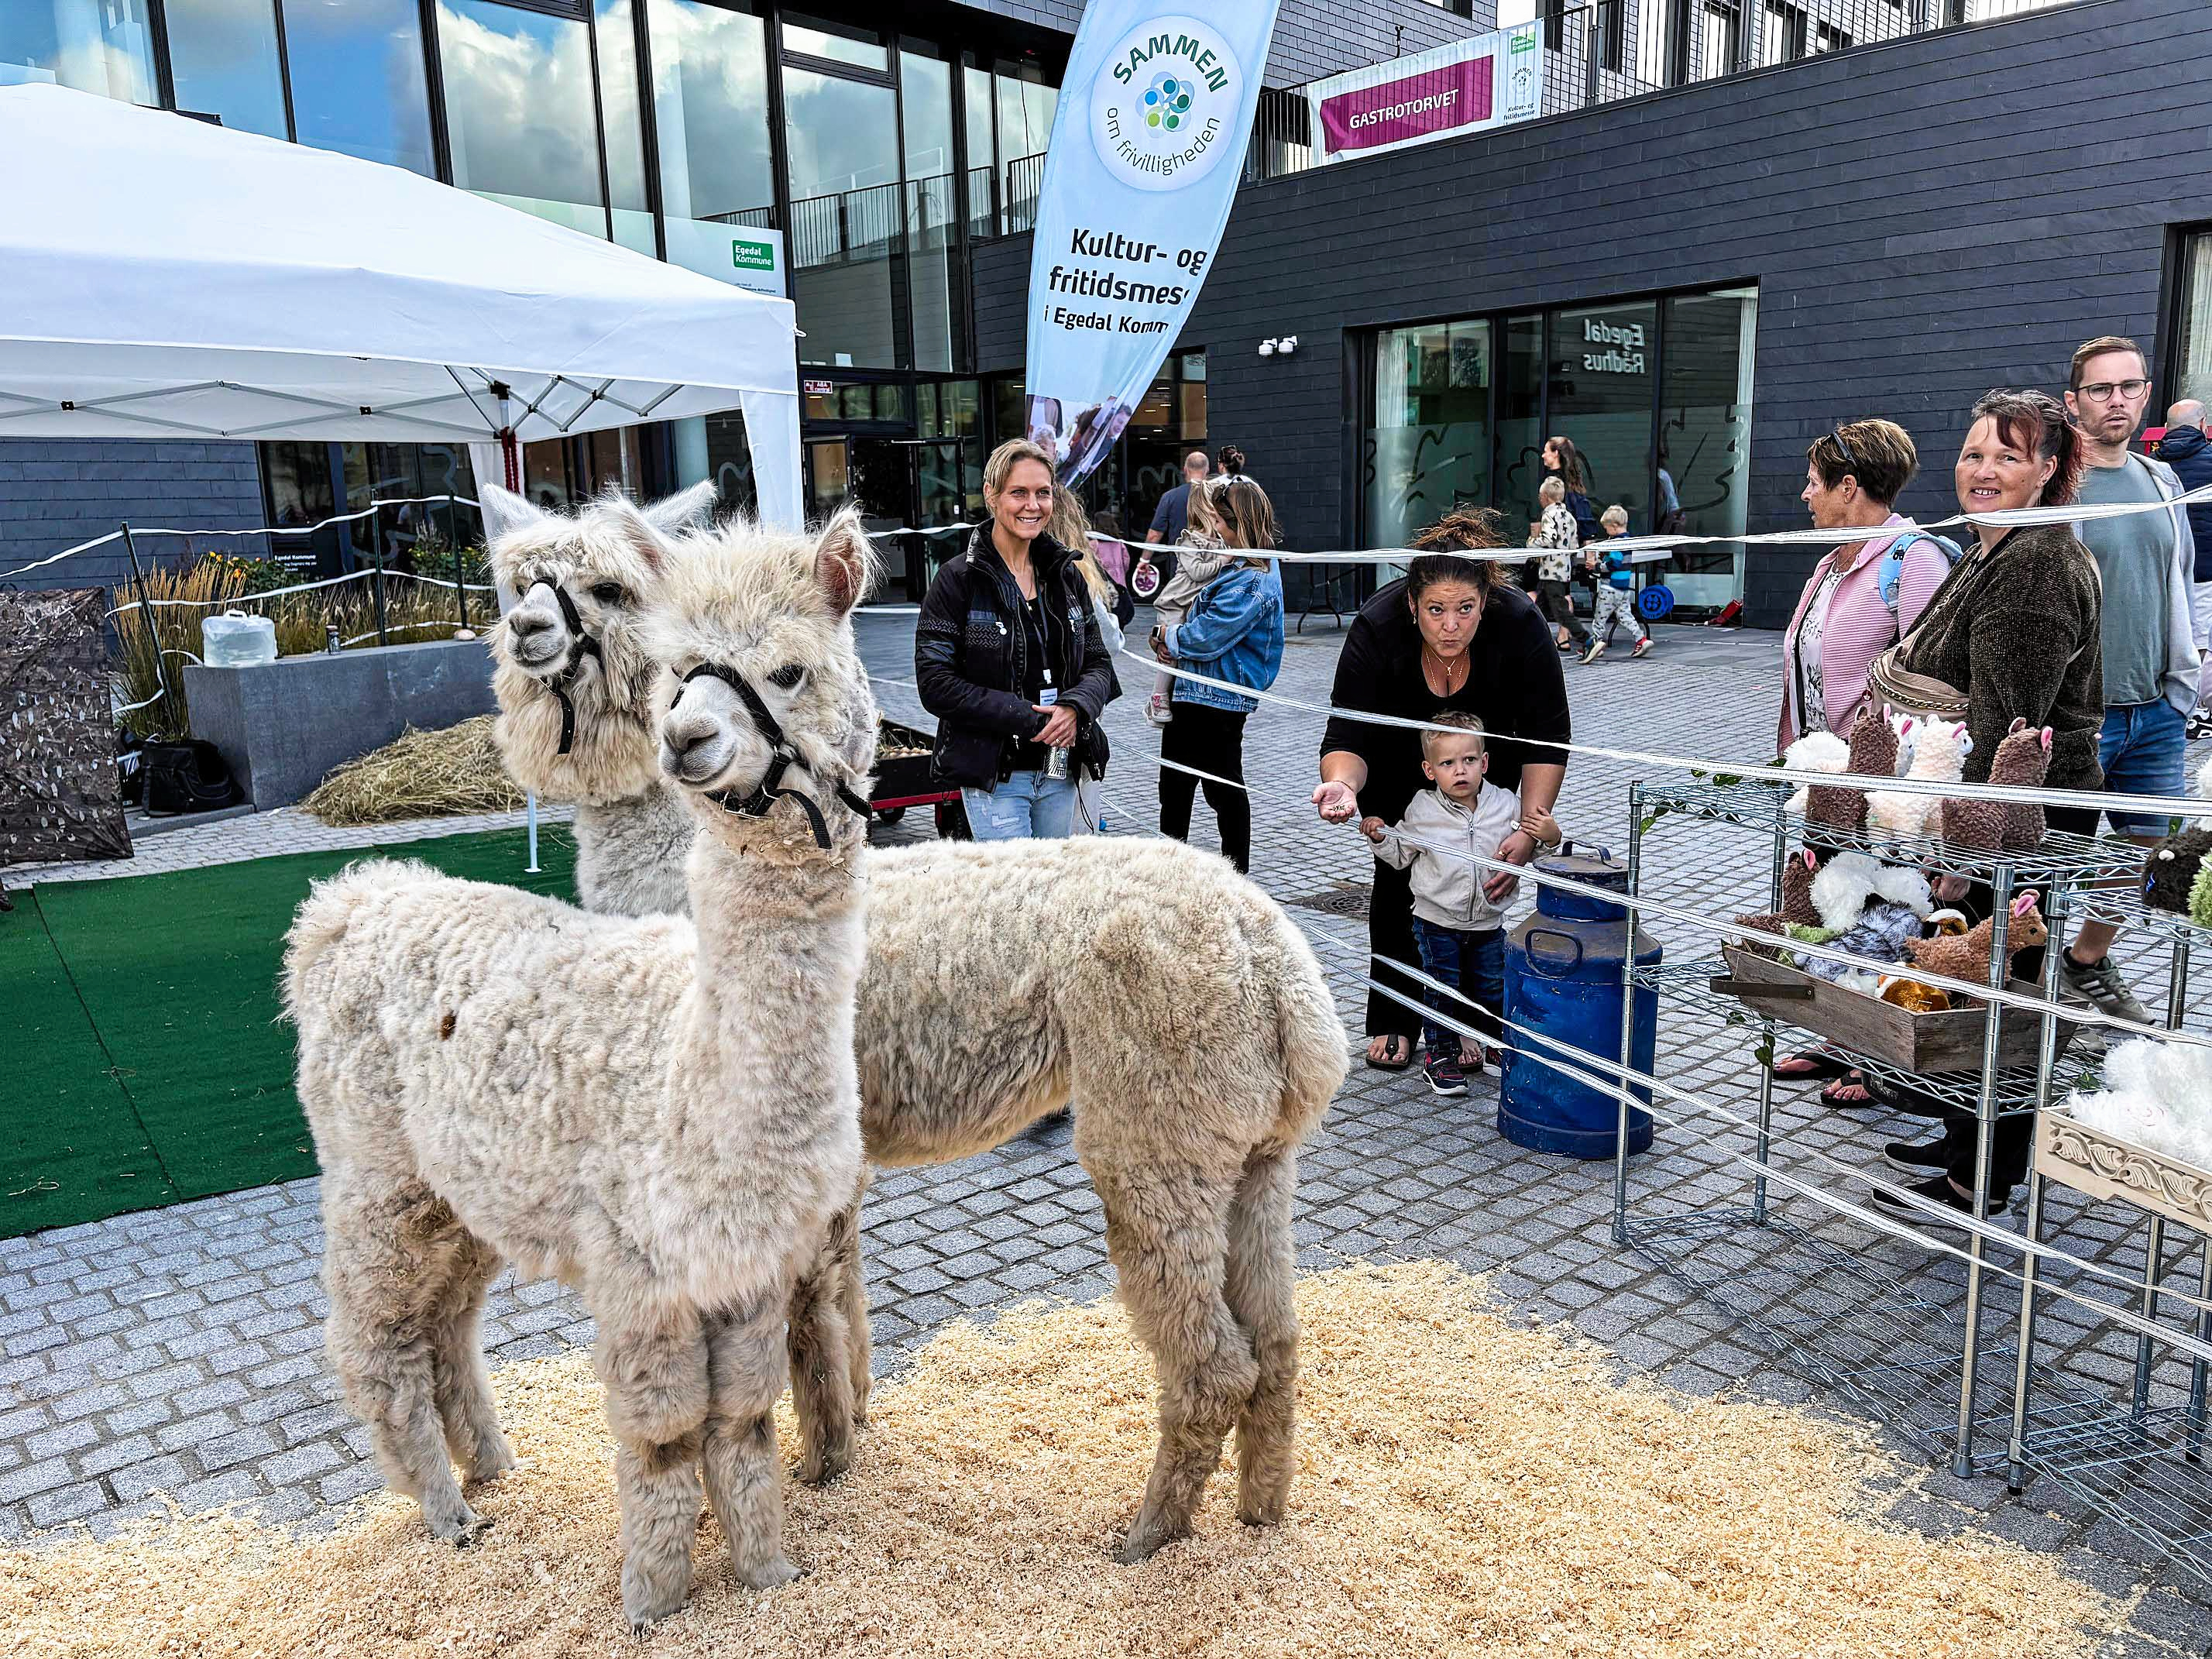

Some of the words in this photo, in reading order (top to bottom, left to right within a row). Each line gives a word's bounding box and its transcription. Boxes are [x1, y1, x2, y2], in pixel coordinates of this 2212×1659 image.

[1113, 33, 1228, 93] SAMMEN
[1349, 88, 1459, 129] GASTROTORVET
[1107, 108, 1121, 139] om
[1116, 117, 1221, 176] frivilligheden
[735, 245, 761, 256] Egedal
[735, 253, 772, 266] Kommune
[1070, 228, 1167, 263] Kultur-
[1176, 248, 1207, 276] og
[1049, 265, 1190, 305] fritidsmes
[1044, 304, 1049, 322] i
[1053, 307, 1112, 331] Egedal
